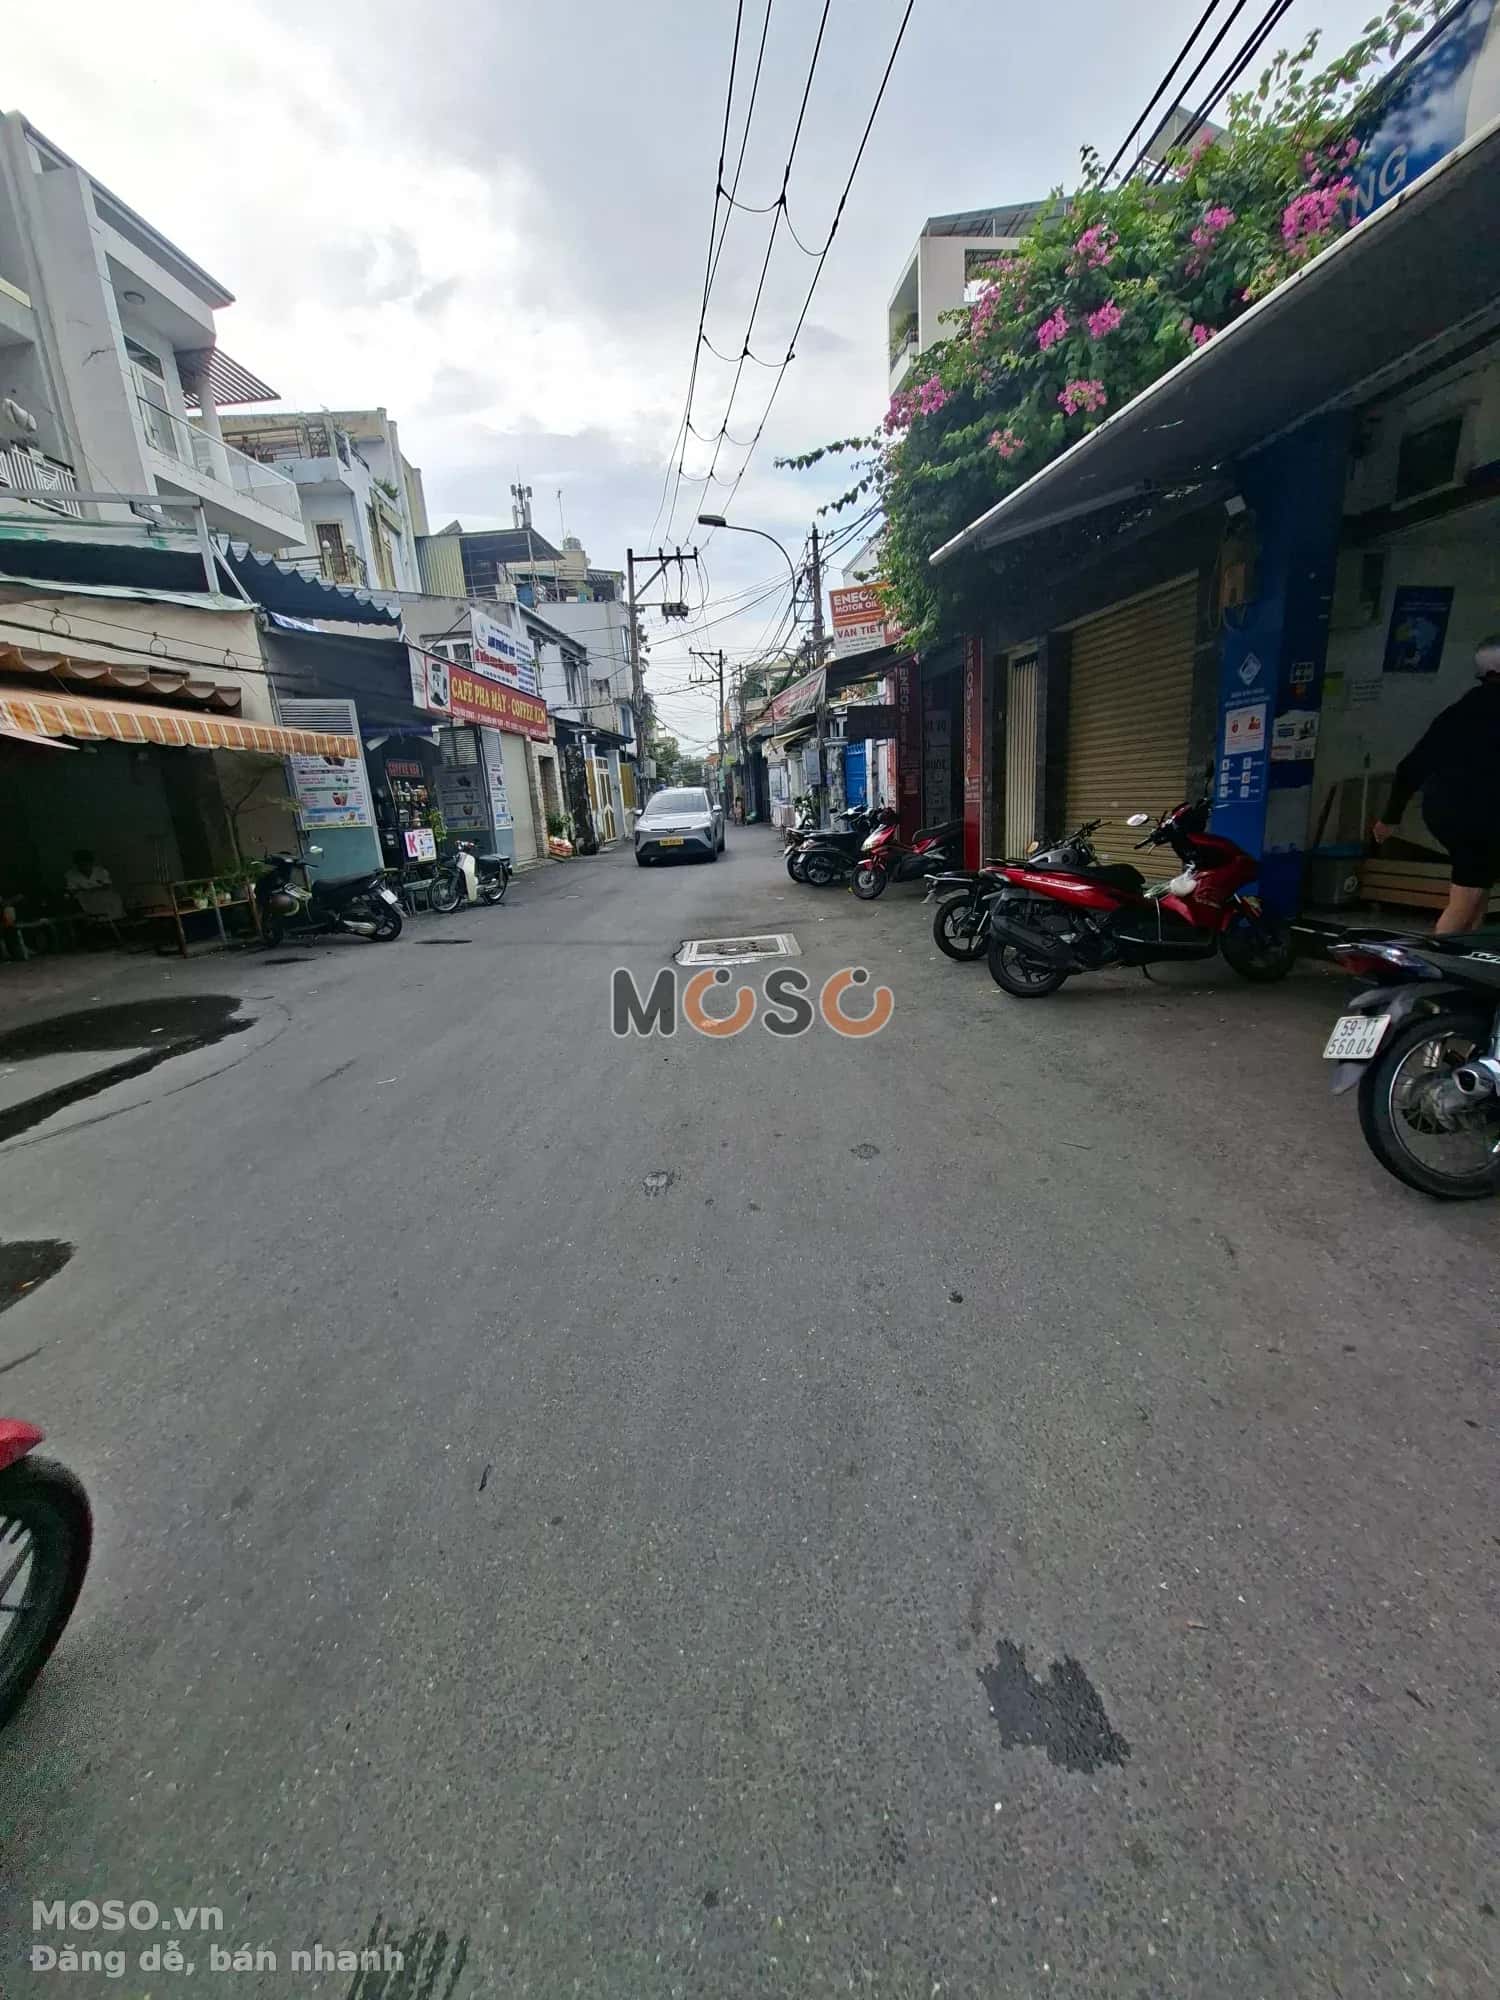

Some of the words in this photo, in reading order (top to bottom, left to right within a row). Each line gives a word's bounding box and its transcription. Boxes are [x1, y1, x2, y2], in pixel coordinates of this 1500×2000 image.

[1349, 143, 1409, 216] NG
[833, 589, 877, 606] ENEO
[835, 602, 864, 613] MOTOR
[865, 600, 878, 609] OIL
[451, 676, 474, 704] CAFÉ
[474, 684, 491, 709] PHA
[511, 697, 534, 721] COFFEE
[900, 666, 910, 713] ENEOS
